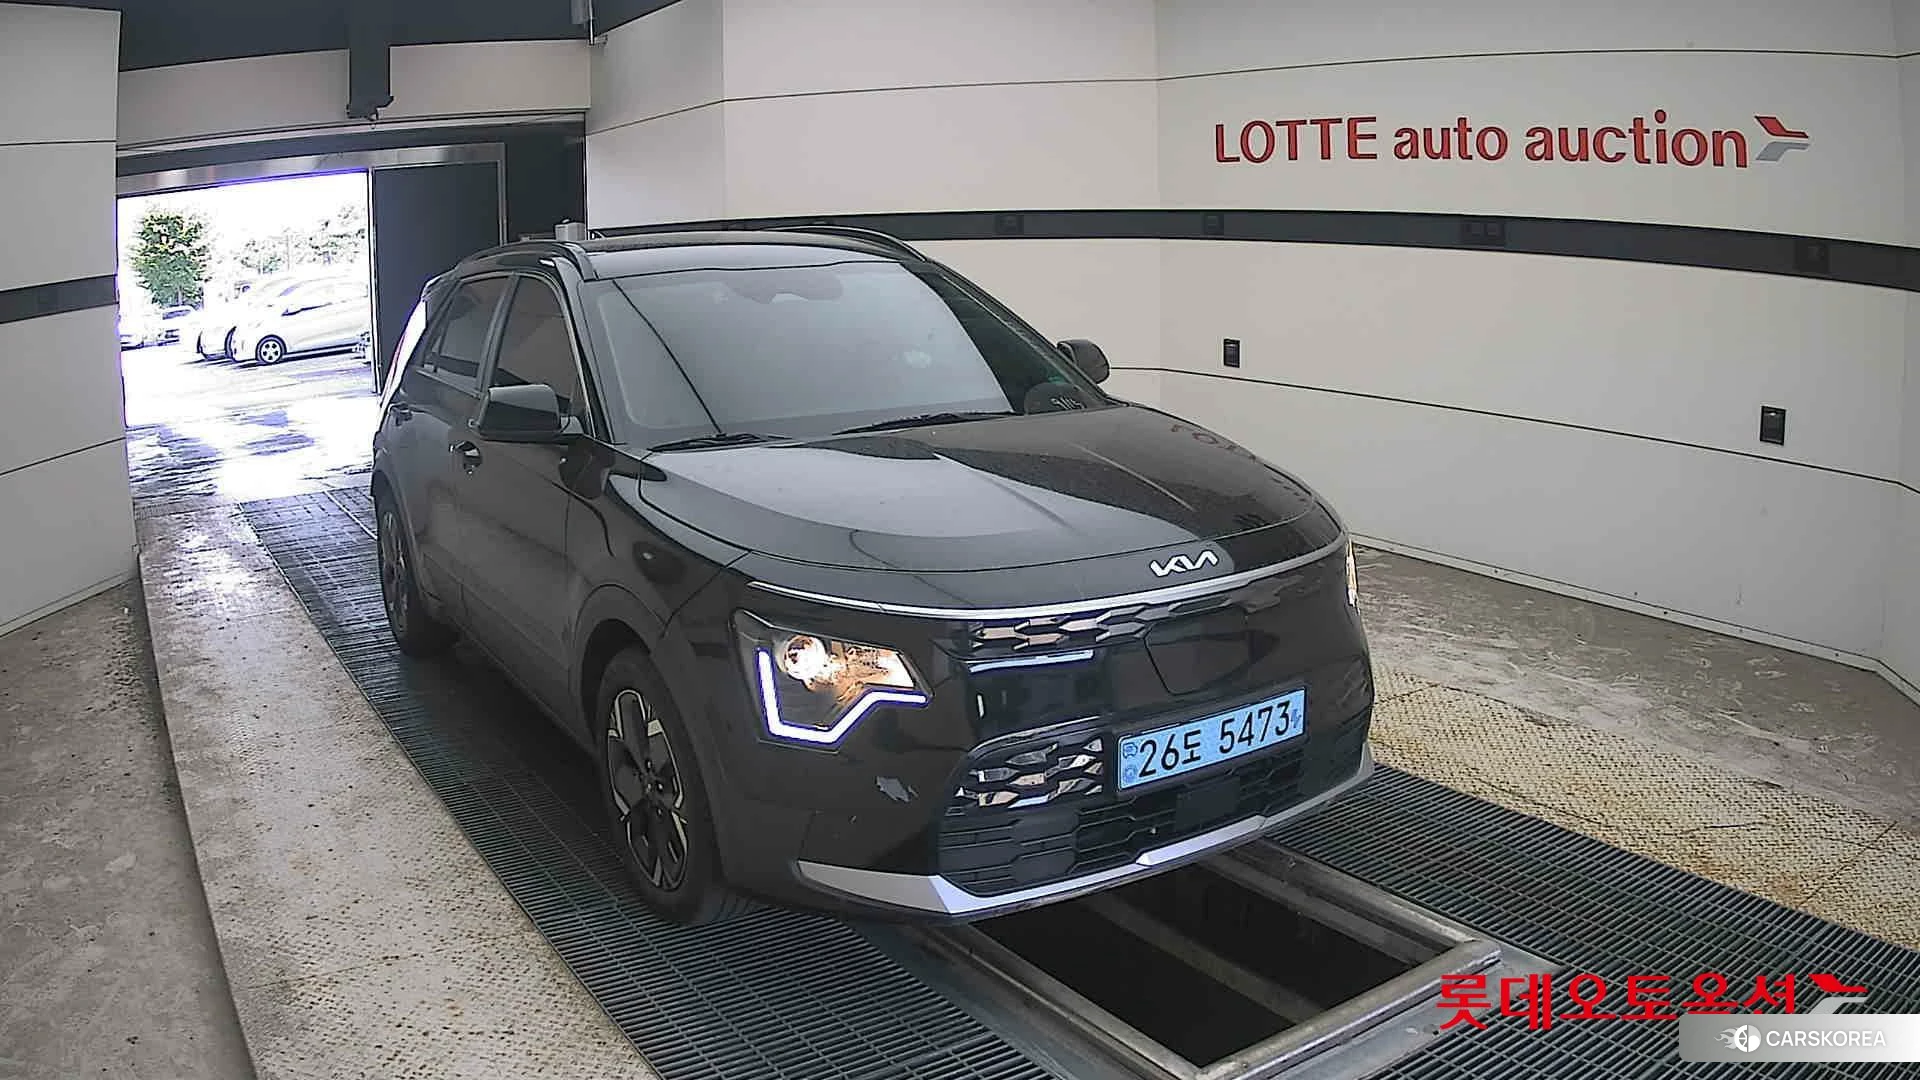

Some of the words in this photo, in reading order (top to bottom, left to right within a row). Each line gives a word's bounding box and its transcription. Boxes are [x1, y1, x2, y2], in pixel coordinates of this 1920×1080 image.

[1215, 117, 1377, 163] LOTTE
[1394, 117, 1509, 161] auto
[1524, 110, 1748, 168] auction
[1150, 550, 1218, 577] KIA
[1138, 731, 1201, 777] 26도
[1219, 700, 1290, 753] 5473
